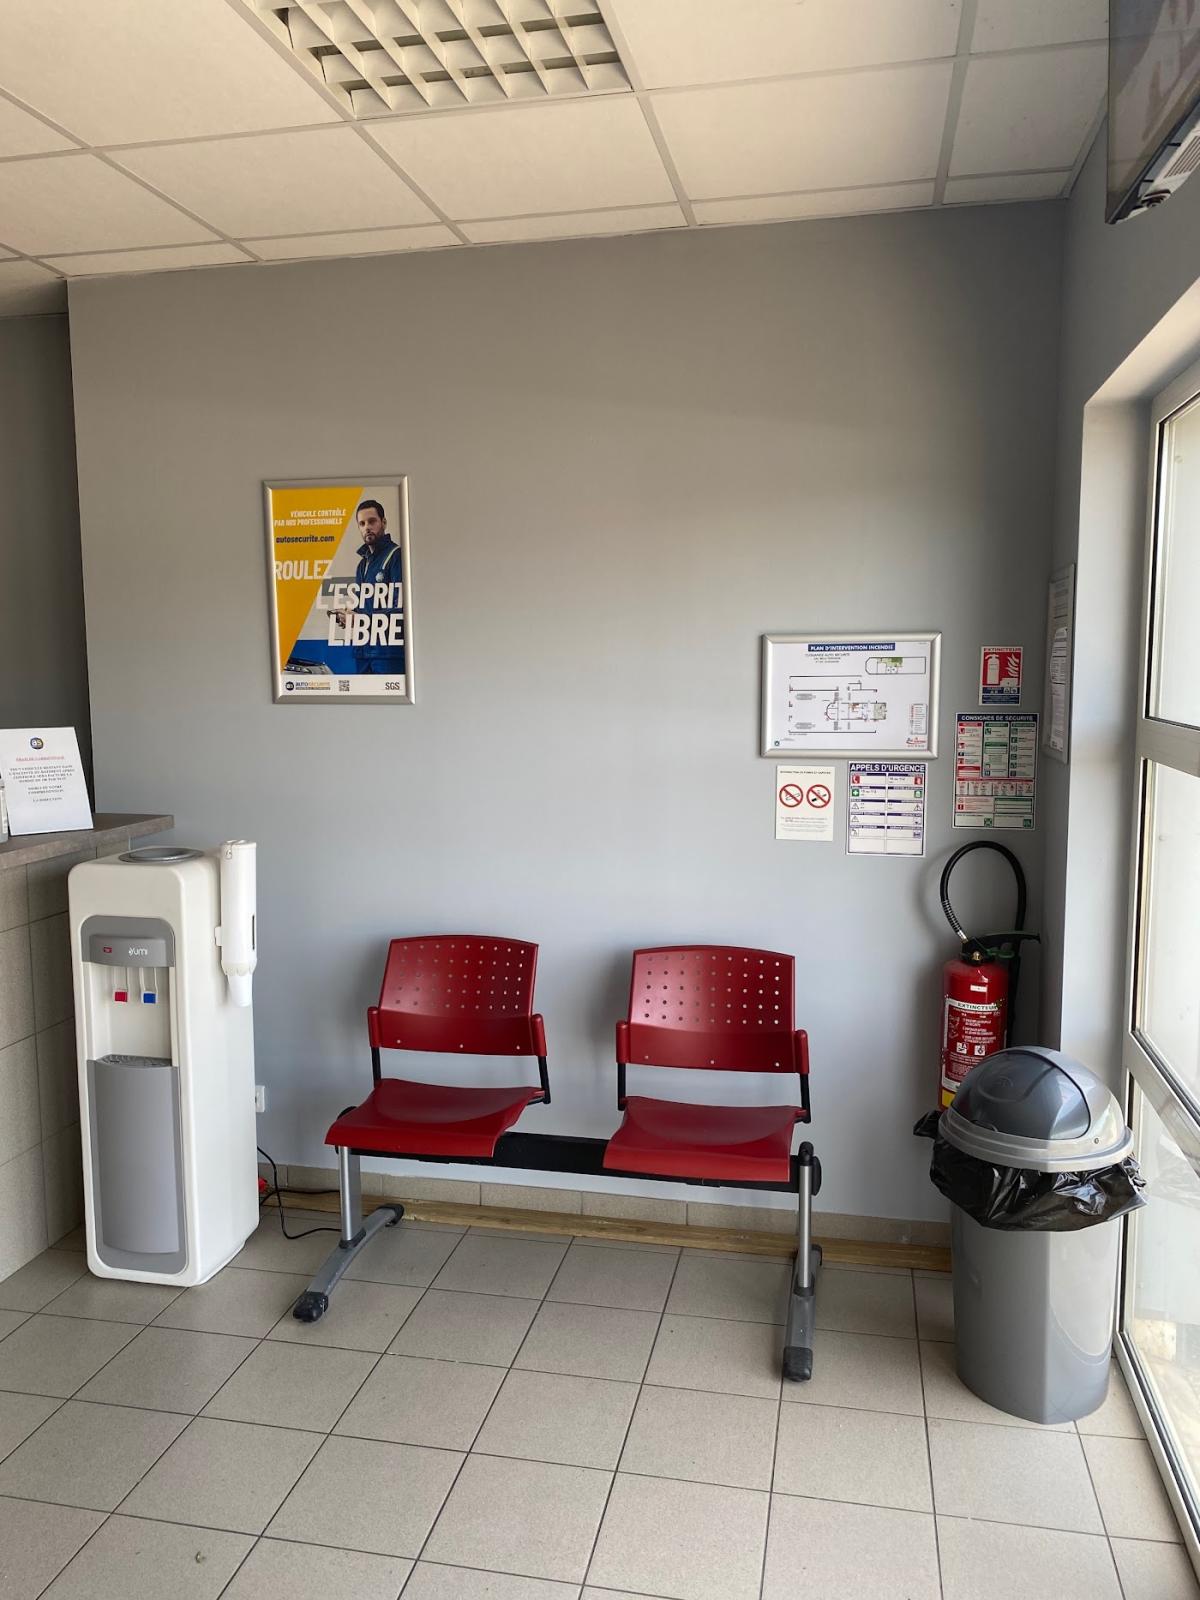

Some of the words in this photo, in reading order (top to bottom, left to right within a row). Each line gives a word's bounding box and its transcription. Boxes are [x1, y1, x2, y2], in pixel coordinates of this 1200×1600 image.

[275, 534, 335, 543] autosecurite.com
[273, 559, 333, 580] ROULEZ
[316, 582, 403, 609] L'ESPRIT
[327, 613, 405, 646] LIBRE
[385, 681, 400, 690] SGS
[850, 764, 880, 772] APPELS
[881, 764, 925, 772] D'URGENCE
